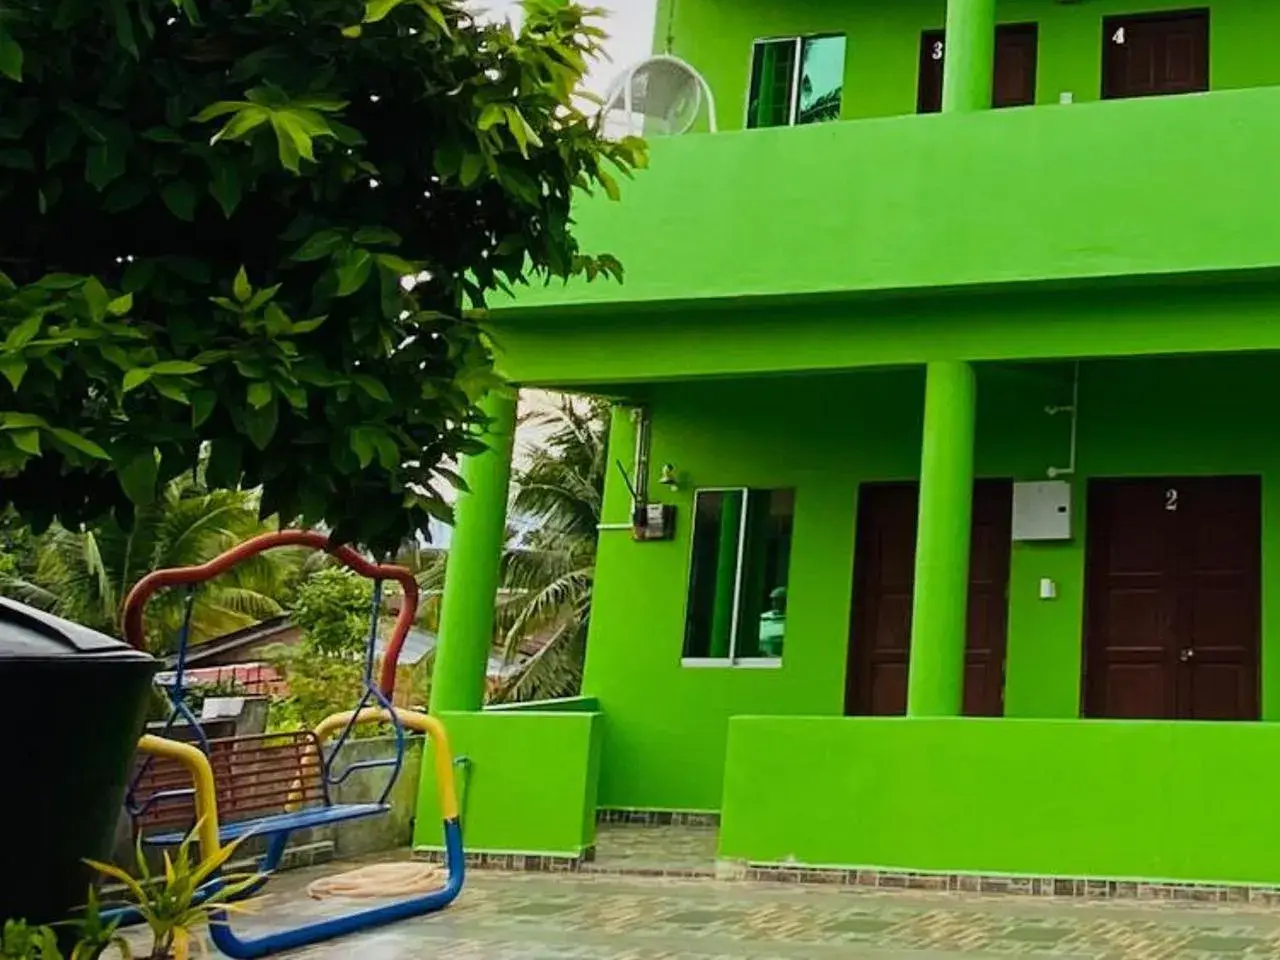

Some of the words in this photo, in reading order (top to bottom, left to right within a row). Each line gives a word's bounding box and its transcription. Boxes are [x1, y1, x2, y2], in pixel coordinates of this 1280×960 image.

[1112, 27, 1125, 44] 4
[932, 41, 943, 60] 3
[1165, 489, 1178, 510] 2
